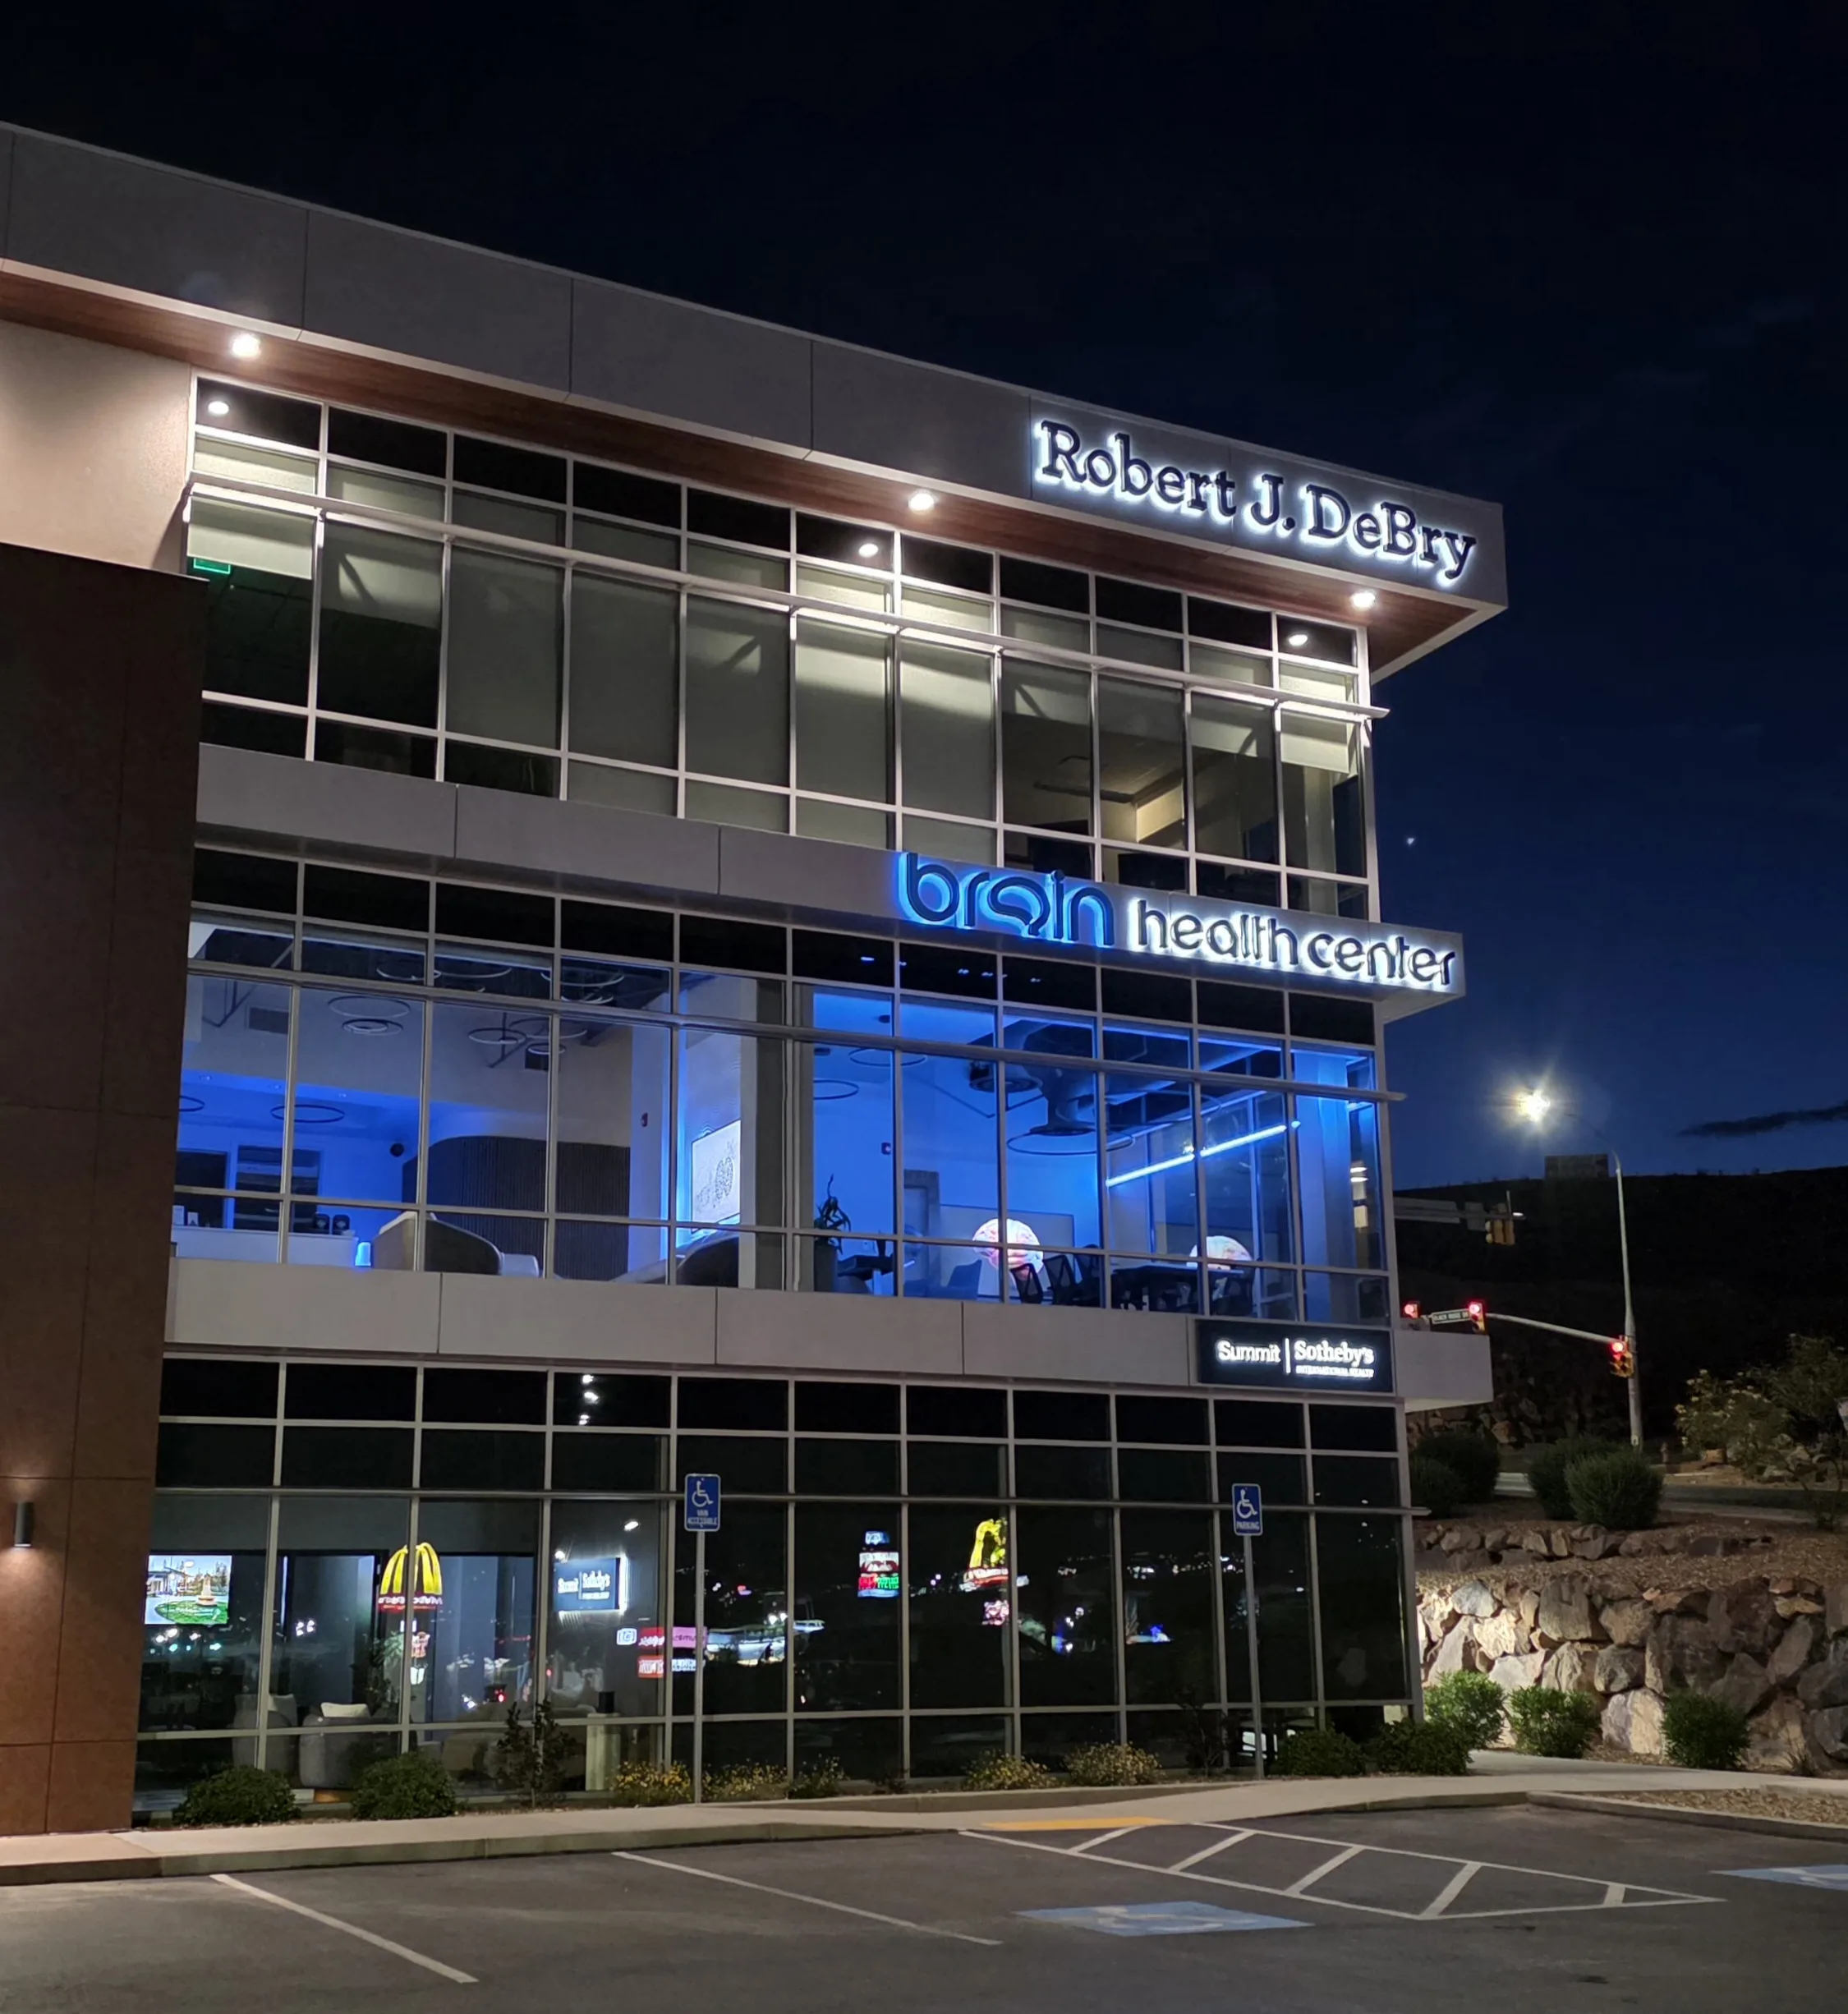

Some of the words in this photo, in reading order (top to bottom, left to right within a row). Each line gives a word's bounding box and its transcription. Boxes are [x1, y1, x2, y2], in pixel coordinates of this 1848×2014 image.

[1041, 420, 1237, 517] Robert
[1250, 473, 1296, 531] J.
[1306, 483, 1477, 579] DeBry
[905, 852, 1115, 945] brain
[1137, 899, 1299, 966] health
[1307, 932, 1456, 986] center
[1217, 1340, 1281, 1363] Summit
[1294, 1340, 1375, 1367] Sotheby's
